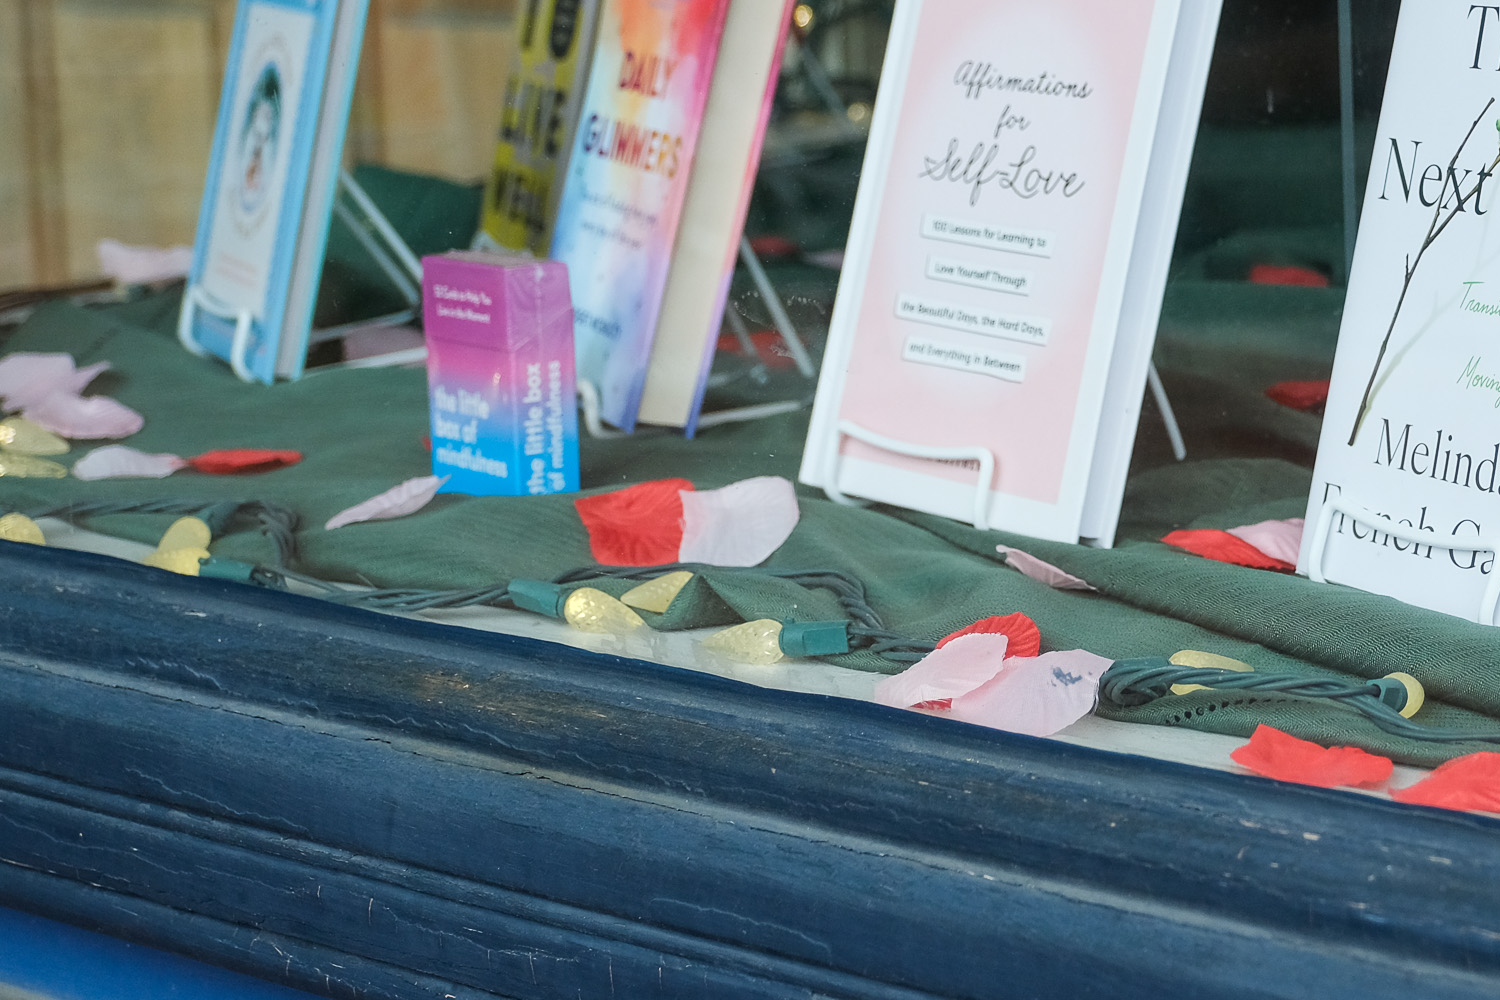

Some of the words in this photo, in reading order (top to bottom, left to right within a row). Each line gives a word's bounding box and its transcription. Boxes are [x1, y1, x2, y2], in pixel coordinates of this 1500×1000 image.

[619, 50, 680, 101] DAILY
[953, 60, 1094, 99] Affirmations
[994, 104, 1031, 139] for
[583, 112, 683, 179] GLIMMERS
[1378, 137, 1493, 215] Next
[933, 220, 947, 231] 100
[950, 225, 981, 238] Lessons
[984, 228, 995, 239] for
[997, 230, 1034, 248] Learning
[1036, 237, 1047, 247] to
[934, 262, 954, 275] Love
[957, 265, 993, 280] Yourself
[993, 271, 1027, 289] Through
[902, 302, 915, 312] the
[918, 304, 954, 319] Beautiful
[956, 310, 979, 326] Days,
[981, 316, 996, 327] the
[998, 319, 1019, 332] Hard
[1020, 322, 1045, 338] Days,
[910, 343, 926, 354] and
[927, 345, 972, 366] Everything
[974, 354, 981, 363] in
[983, 356, 1022, 372] Between
[523, 362, 543, 404] box
[433, 384, 457, 413] the
[457, 388, 490, 420] little
[546, 359, 564, 469] mindfulness
[434, 413, 462, 442] box
[461, 418, 479, 444] of
[524, 406, 545, 456] little
[435, 442, 509, 479] mindfulness
[525, 458, 546, 495] the
[547, 471, 566, 492] of
